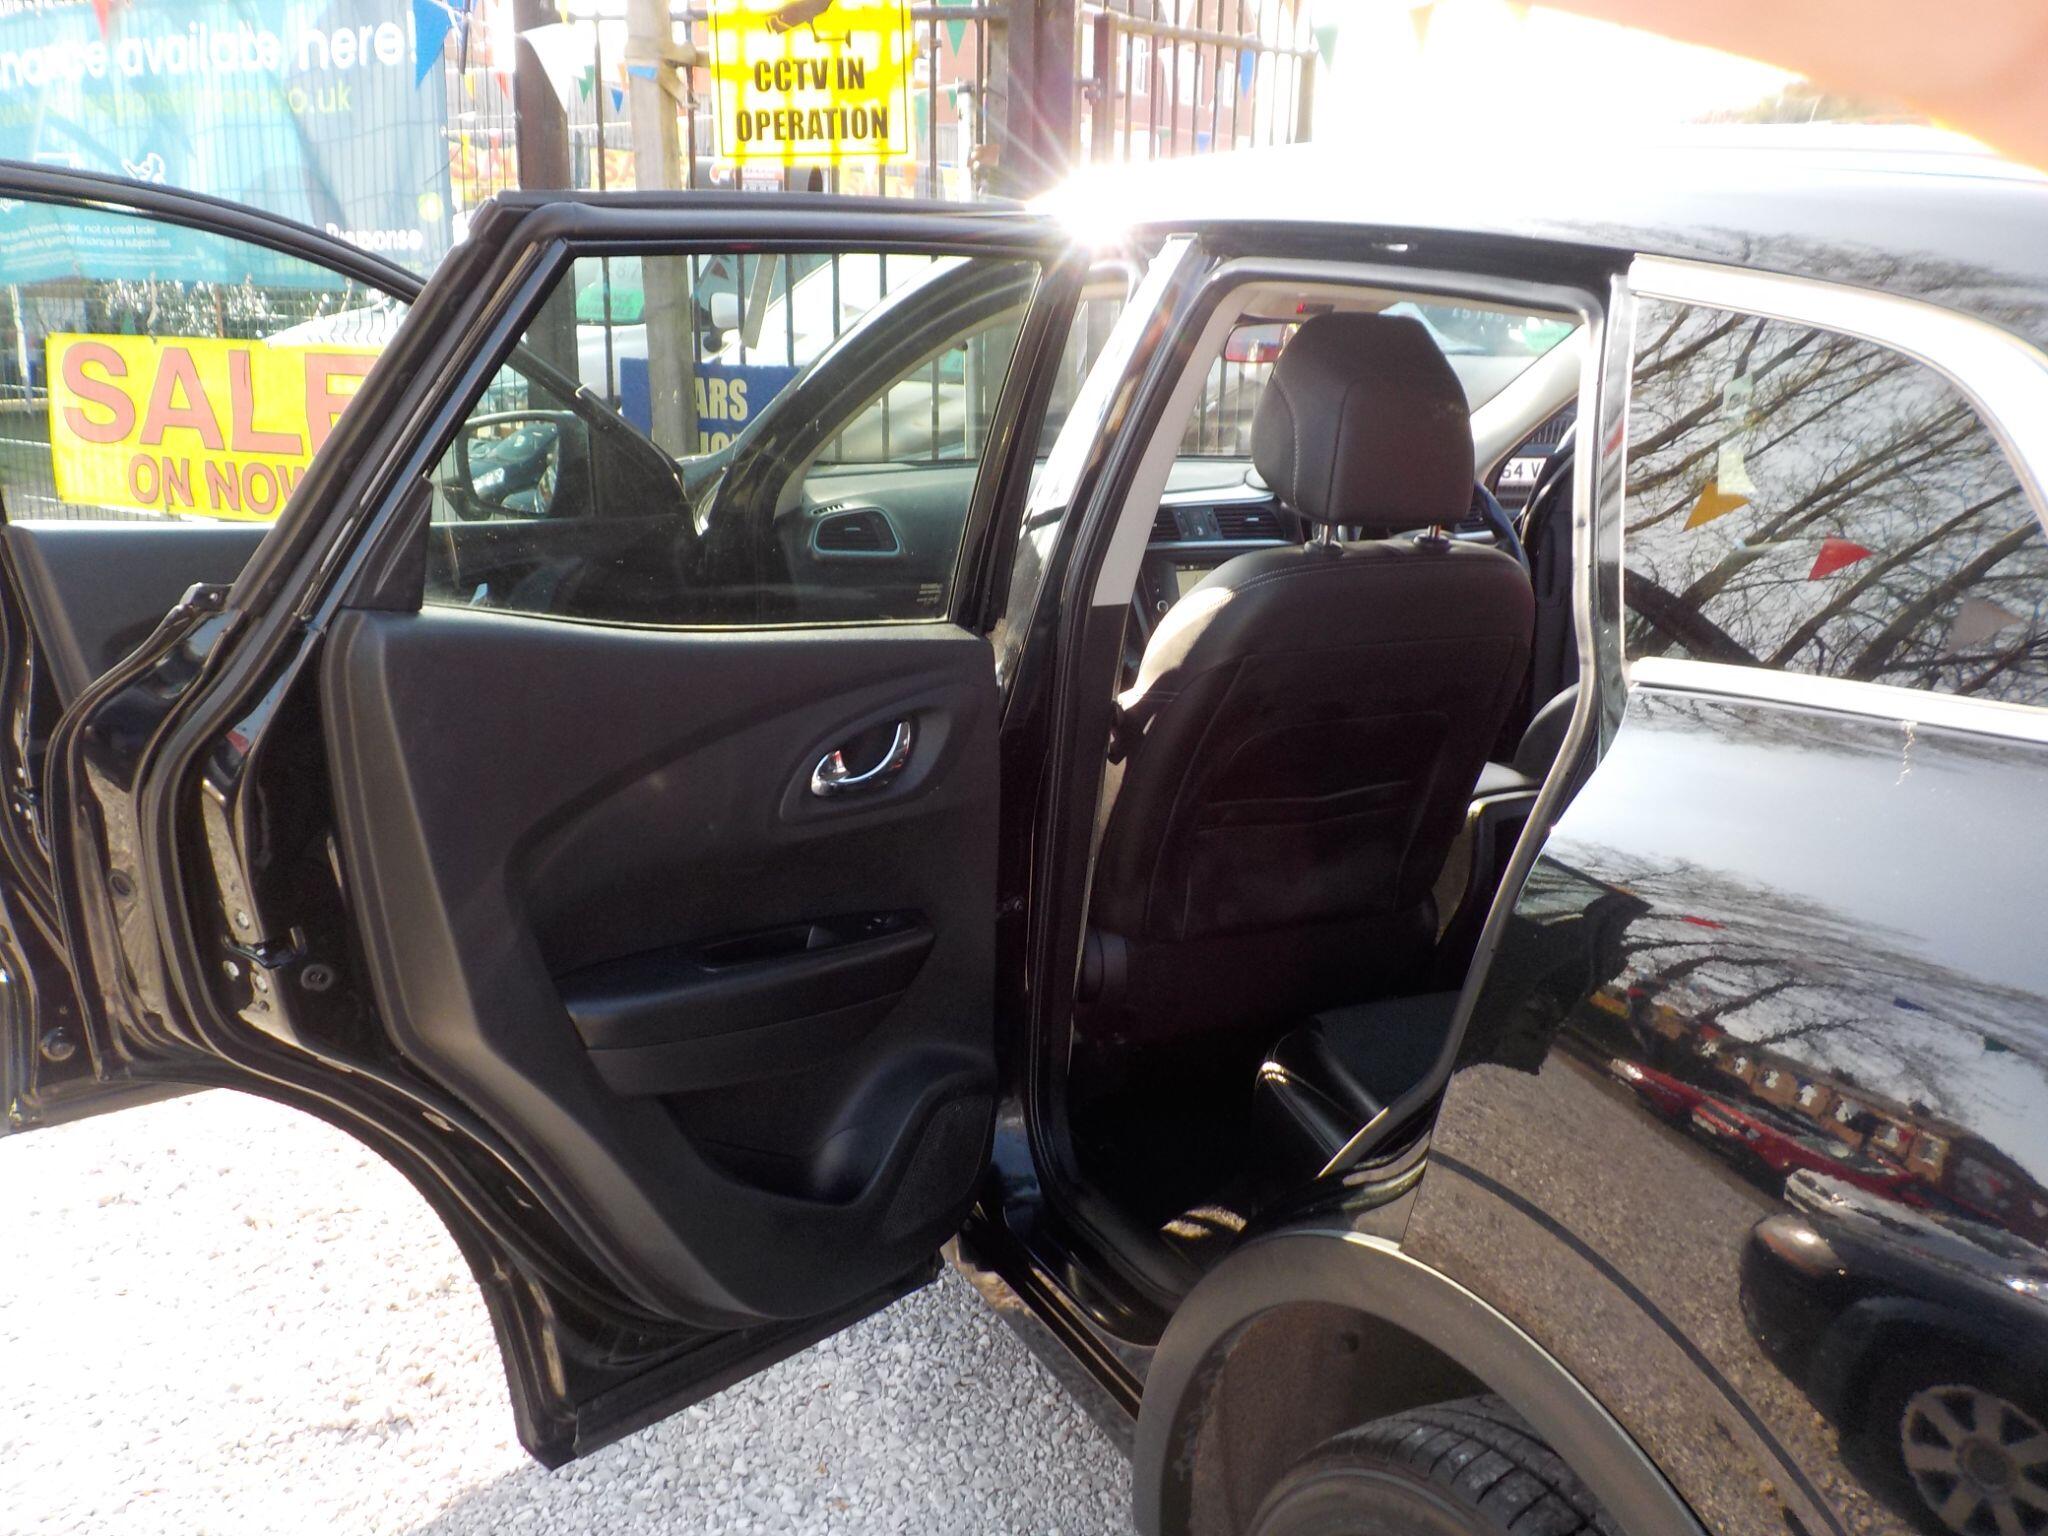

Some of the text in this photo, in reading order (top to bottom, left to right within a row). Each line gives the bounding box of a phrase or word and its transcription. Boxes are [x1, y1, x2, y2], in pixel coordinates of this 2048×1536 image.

[754, 57, 866, 92] CCTV IN
[736, 106, 889, 142] OPERATION
[694, 376, 748, 421] ARS
[128, 454, 194, 507] ON
